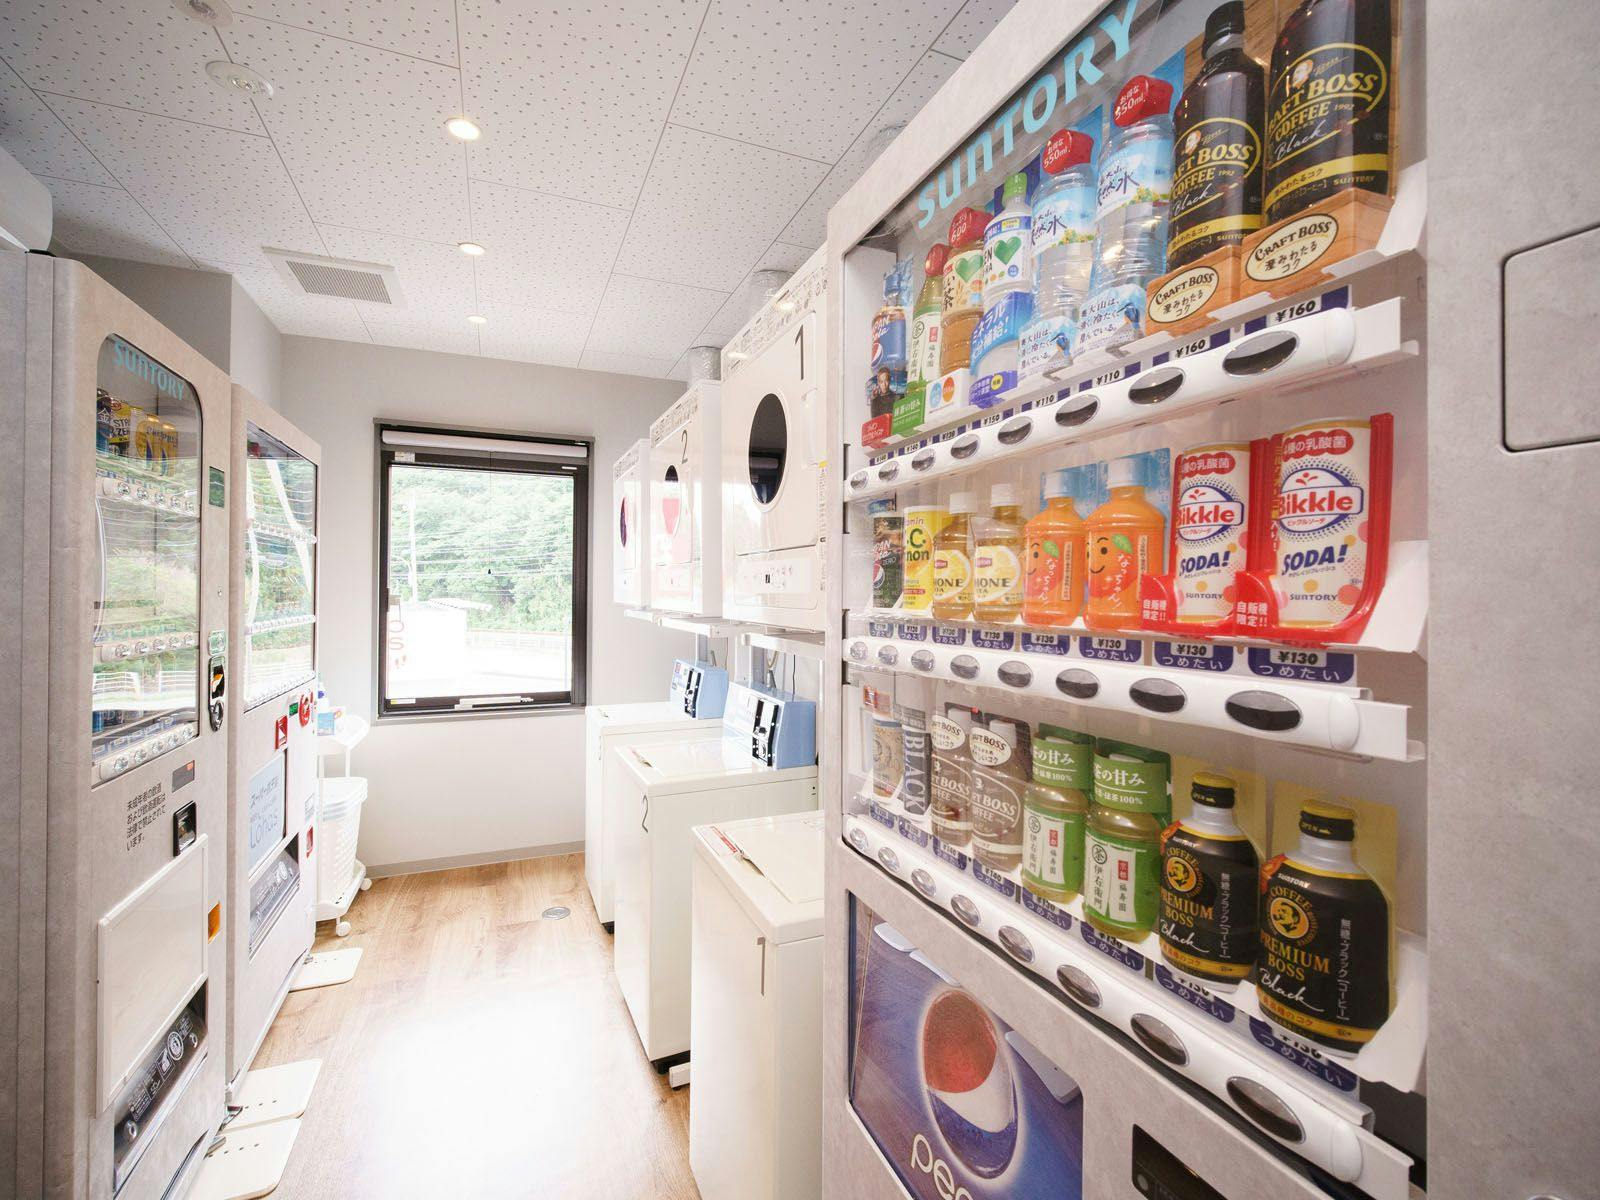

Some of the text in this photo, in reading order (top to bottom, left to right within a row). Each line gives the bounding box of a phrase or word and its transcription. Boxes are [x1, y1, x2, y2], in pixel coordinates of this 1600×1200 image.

[1307, 72, 1378, 99] BOSS
[917, 0, 1138, 229] SUNTORY
[1275, 101, 1332, 142] COFFEE
[1275, 119, 1327, 160] Black
[1197, 143, 1253, 163] BOSS
[1173, 167, 1216, 199] COFFEE
[1173, 183, 1213, 216] Black
[1255, 221, 1333, 261] CRAFT BOSS
[1265, 240, 1318, 271] 澄みわたる
[1282, 258, 1302, 274] コク
[1155, 271, 1215, 305] CRAFT BOSS
[1163, 290, 1203, 315] 澄みわたる
[1176, 304, 1191, 317] コク
[1276, 300, 1316, 322] ¥160
[794, 324, 804, 381] 1
[1176, 339, 1206, 357] ¥160
[112, 339, 184, 400] SUNTORY
[1096, 370, 1120, 385] ¥110
[1036, 395, 1055, 407] ¥110
[983, 414, 1000, 425] ¥150
[681, 430, 689, 464] 2
[1180, 550, 1230, 576] SODA!
[1281, 544, 1348, 575] SODA!
[1143, 599, 1167, 611] 自販機
[1237, 602, 1267, 615] 自販機
[1290, 593, 1338, 601] SUNTORY
[935, 636, 963, 644] つめたい
[977, 640, 1009, 649] つめたい
[984, 631, 1000, 640] ¥130
[1036, 634, 1054, 643] ¥130
[1098, 638, 1121, 649] ¥130
[1025, 643, 1065, 654] つめたい
[1085, 649, 1134, 661] つめたい
[1177, 644, 1207, 656] ¥130
[1278, 650, 1319, 665] ¥130
[1162, 656, 1223, 670] つめたい
[1259, 665, 1340, 681] つめたい
[942, 722, 962, 736] BOSS
[983, 735, 1007, 751] BOSS
[904, 730, 926, 815] BLACK
[940, 778, 971, 795] BOSS
[982, 795, 1017, 816] BOSS
[1167, 847, 1200, 868] COFFEE
[976, 873, 1010, 896] つめたい
[1094, 865, 1103, 909] 伊右衛門
[1278, 872, 1311, 888] SUNTORY
[1160, 887, 1215, 921] PREMIUM
[1270, 885, 1312, 911] COFFEE
[1027, 901, 1066, 927] つめたい
[1165, 905, 1195, 928] BOSS
[1160, 918, 1210, 953] Black
[1088, 935, 1136, 967] つめたい
[1260, 928, 1331, 974] PREMIUM
[1268, 953, 1305, 982] BOSS
[1162, 979, 1224, 1020] つめたい
[1259, 967, 1325, 1013] Black
[1261, 1034, 1343, 1087] つめたい
